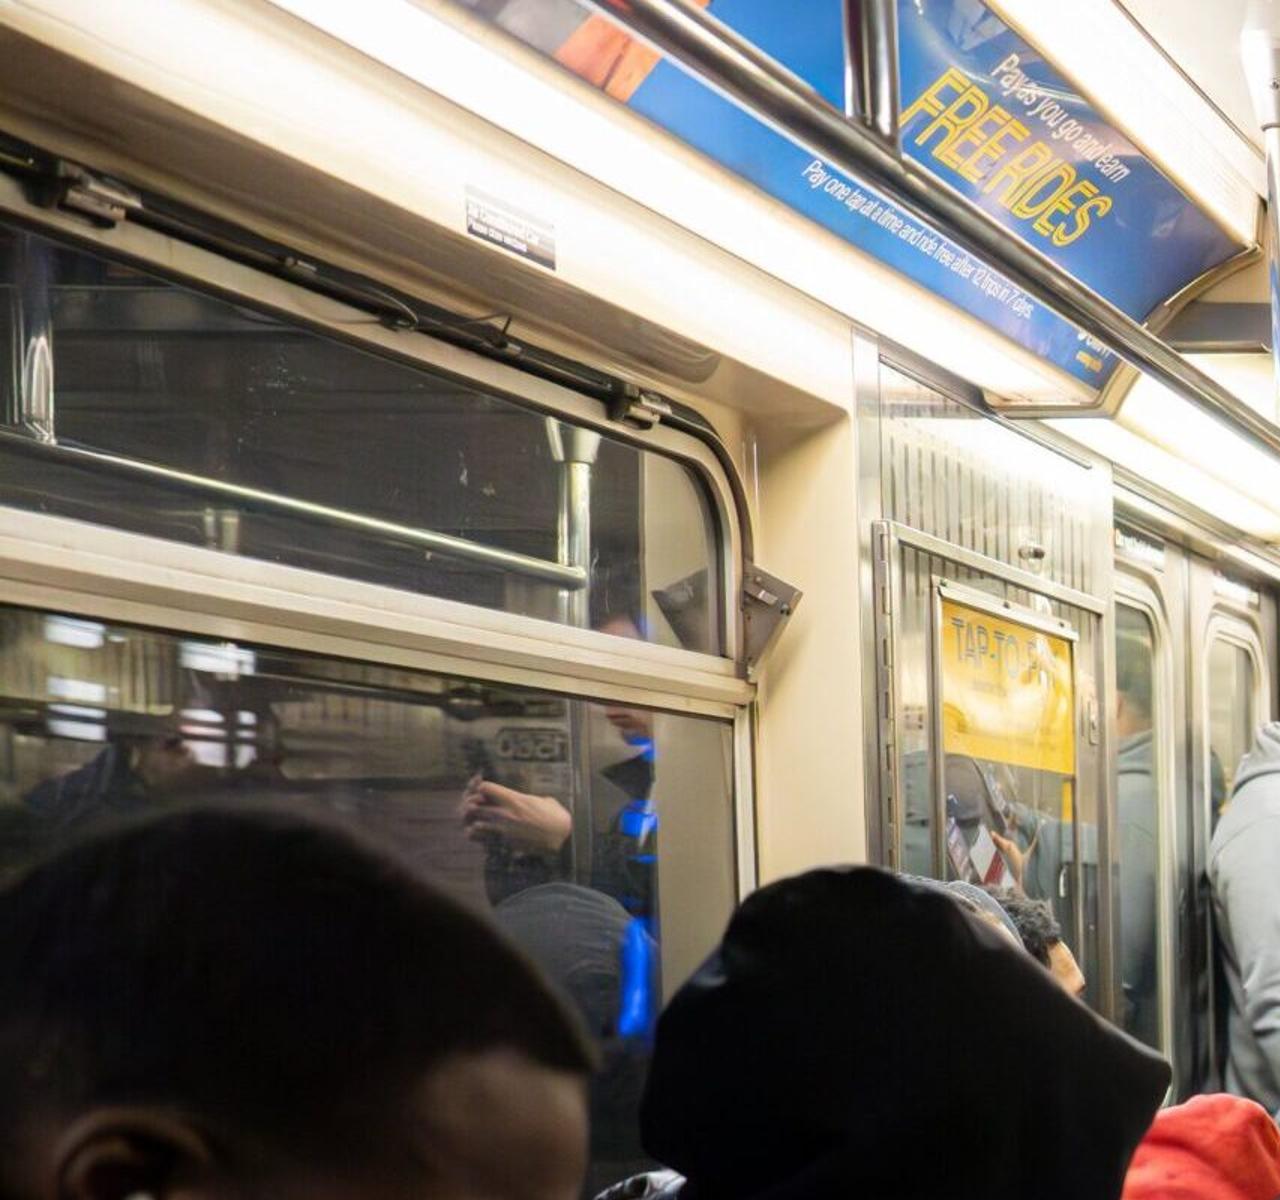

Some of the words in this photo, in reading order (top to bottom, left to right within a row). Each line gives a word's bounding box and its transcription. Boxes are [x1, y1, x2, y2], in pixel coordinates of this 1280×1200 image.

[898, 66, 1032, 186] FREE
[981, 140, 1113, 247] RIDES
[990, 53, 1028, 97] Pay
[1015, 81, 1039, 105] as
[1027, 94, 1067, 127] you
[1051, 114, 1084, 141] go
[1071, 129, 1112, 163] and
[1094, 149, 1131, 184] earn
[801, 159, 831, 189] Pay
[823, 177, 851, 201] one
[844, 188, 867, 212] tap
[859, 199, 880, 217] at
[877, 208, 904, 235] time
[898, 223, 926, 246] and
[915, 230, 939, 256] ride
[931, 240, 957, 267] free
